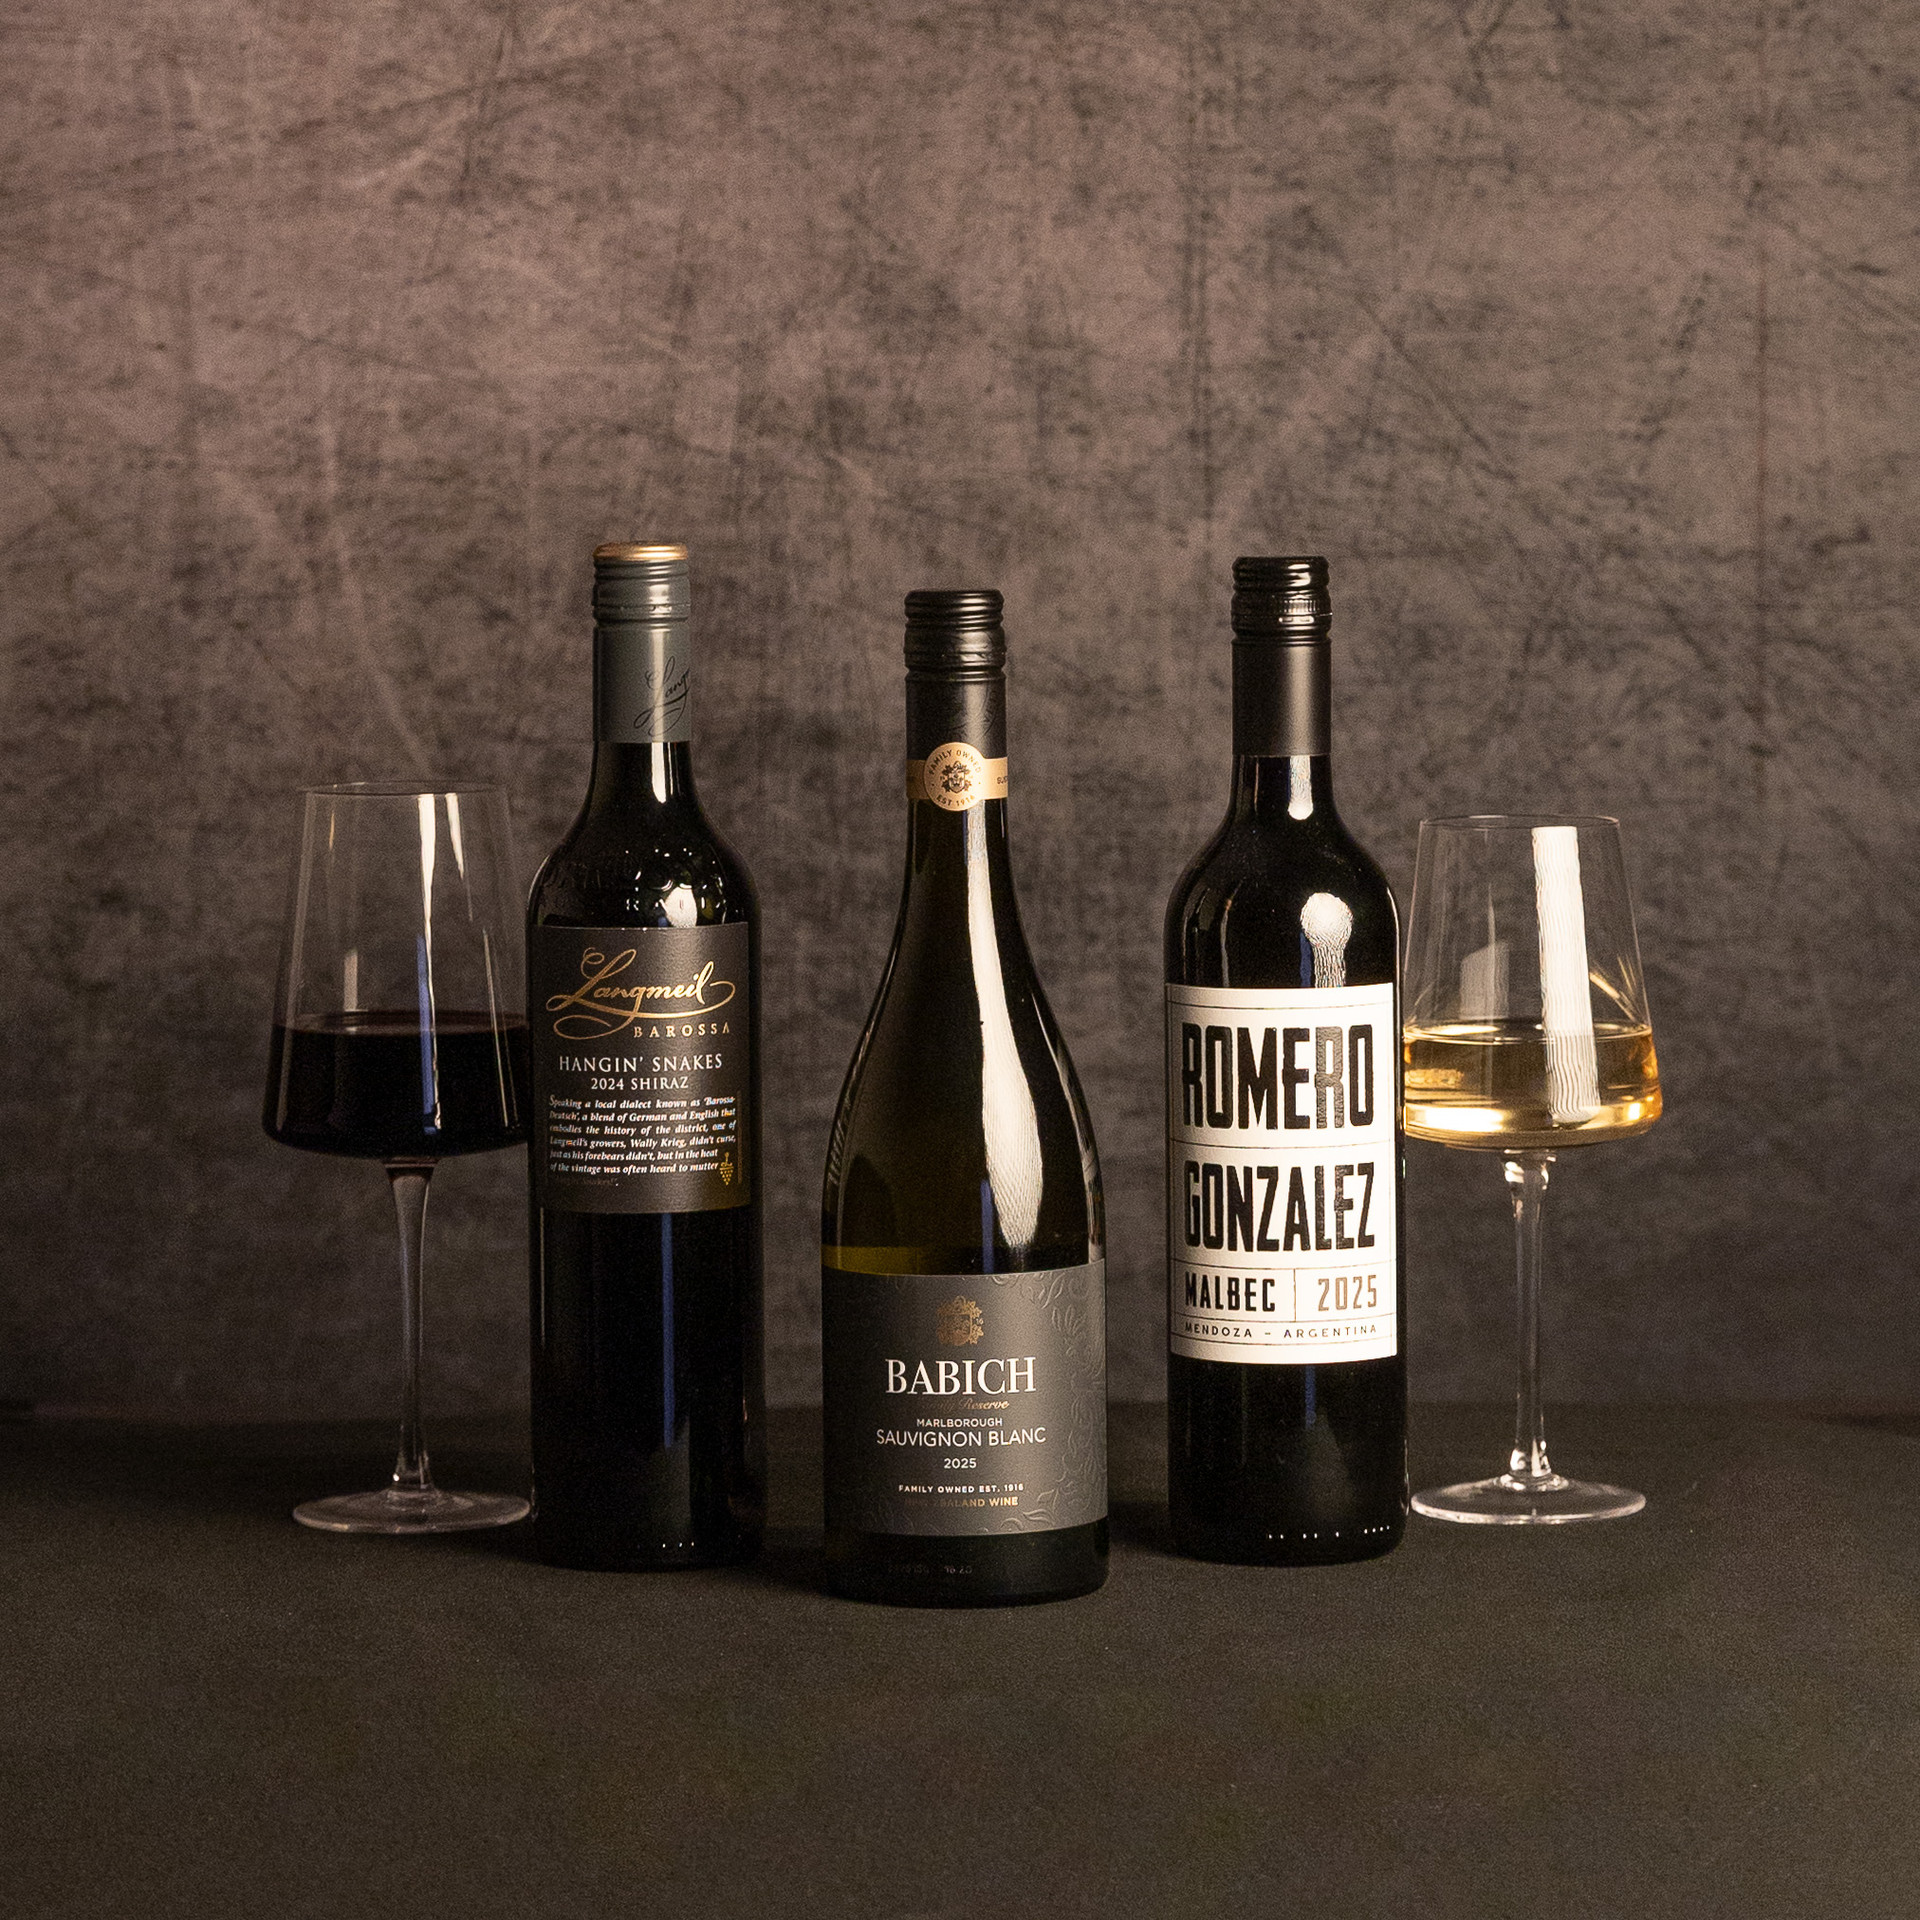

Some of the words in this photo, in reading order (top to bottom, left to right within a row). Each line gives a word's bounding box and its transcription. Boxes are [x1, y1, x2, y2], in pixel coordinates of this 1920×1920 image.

[928, 749, 952, 775] FAMILY
[956, 749, 981, 773] OWNED
[936, 794, 952, 806] EST
[546, 947, 736, 1040] Langmeil
[633, 1022, 730, 1038] BAROSSA
[559, 1055, 643, 1073] HANGIN'
[652, 1053, 722, 1072] SNAKES
[591, 1077, 624, 1090] 2024
[631, 1076, 689, 1090] SHIRAZ
[1182, 1022, 1374, 1130] ROMERO
[549, 1094, 582, 1109] Speaking
[595, 1100, 616, 1108] local
[620, 1100, 651, 1108] dialect
[656, 1099, 687, 1108] known
[590, 1113, 614, 1121] blend
[617, 1113, 628, 1123] of
[629, 1113, 667, 1121] German
[669, 1111, 688, 1120] and
[690, 1109, 719, 1121] English
[721, 1108, 736, 1117] that
[549, 1124, 582, 1133] embodies
[586, 1125, 600, 1134] the
[604, 1125, 637, 1136] history
[640, 1126, 652, 1136] of
[656, 1125, 671, 1134] the
[675, 1123, 709, 1133] district,
[712, 1123, 726, 1131] one
[729, 1120, 736, 1131] of
[590, 1141, 627, 1149] growers,
[630, 1139, 658, 1150] Wally
[689, 1136, 714, 1146] didn't
[549, 1150, 562, 1159] just
[572, 1151, 583, 1160] his
[585, 1151, 624, 1161] forebears
[625, 1151, 656, 1161] didn't,
[657, 1151, 673, 1160] but
[675, 1151, 684, 1159] in
[686, 1150, 699, 1158] the
[701, 1149, 718, 1158] heat
[549, 1163, 557, 1172] of
[558, 1163, 569, 1171] the
[571, 1164, 601, 1175] vintage
[622, 1165, 647, 1176] often
[649, 1163, 676, 1173] heard
[679, 1163, 688, 1172] to
[690, 1162, 718, 1172] mutter
[1184, 1160, 1375, 1252] GONZALEZ
[1185, 1271, 1275, 1312] MALBEC
[1318, 1275, 1377, 1311] 2025
[1185, 1322, 1252, 1338] MENDOZA
[1284, 1325, 1377, 1339] ARGENTINA
[885, 1356, 1037, 1395] BABICH
[959, 1397, 1010, 1410] Reserve
[916, 1417, 1003, 1428] MARLBOROUGH
[876, 1429, 982, 1447] SAUVIGNON
[988, 1427, 1046, 1446] BLANC
[943, 1457, 977, 1469] 2025
[898, 1484, 933, 1493] FAMILY
[937, 1485, 975, 1493] OWNED
[979, 1485, 1000, 1493] EST.
[989, 1496, 1019, 1506] WINE
